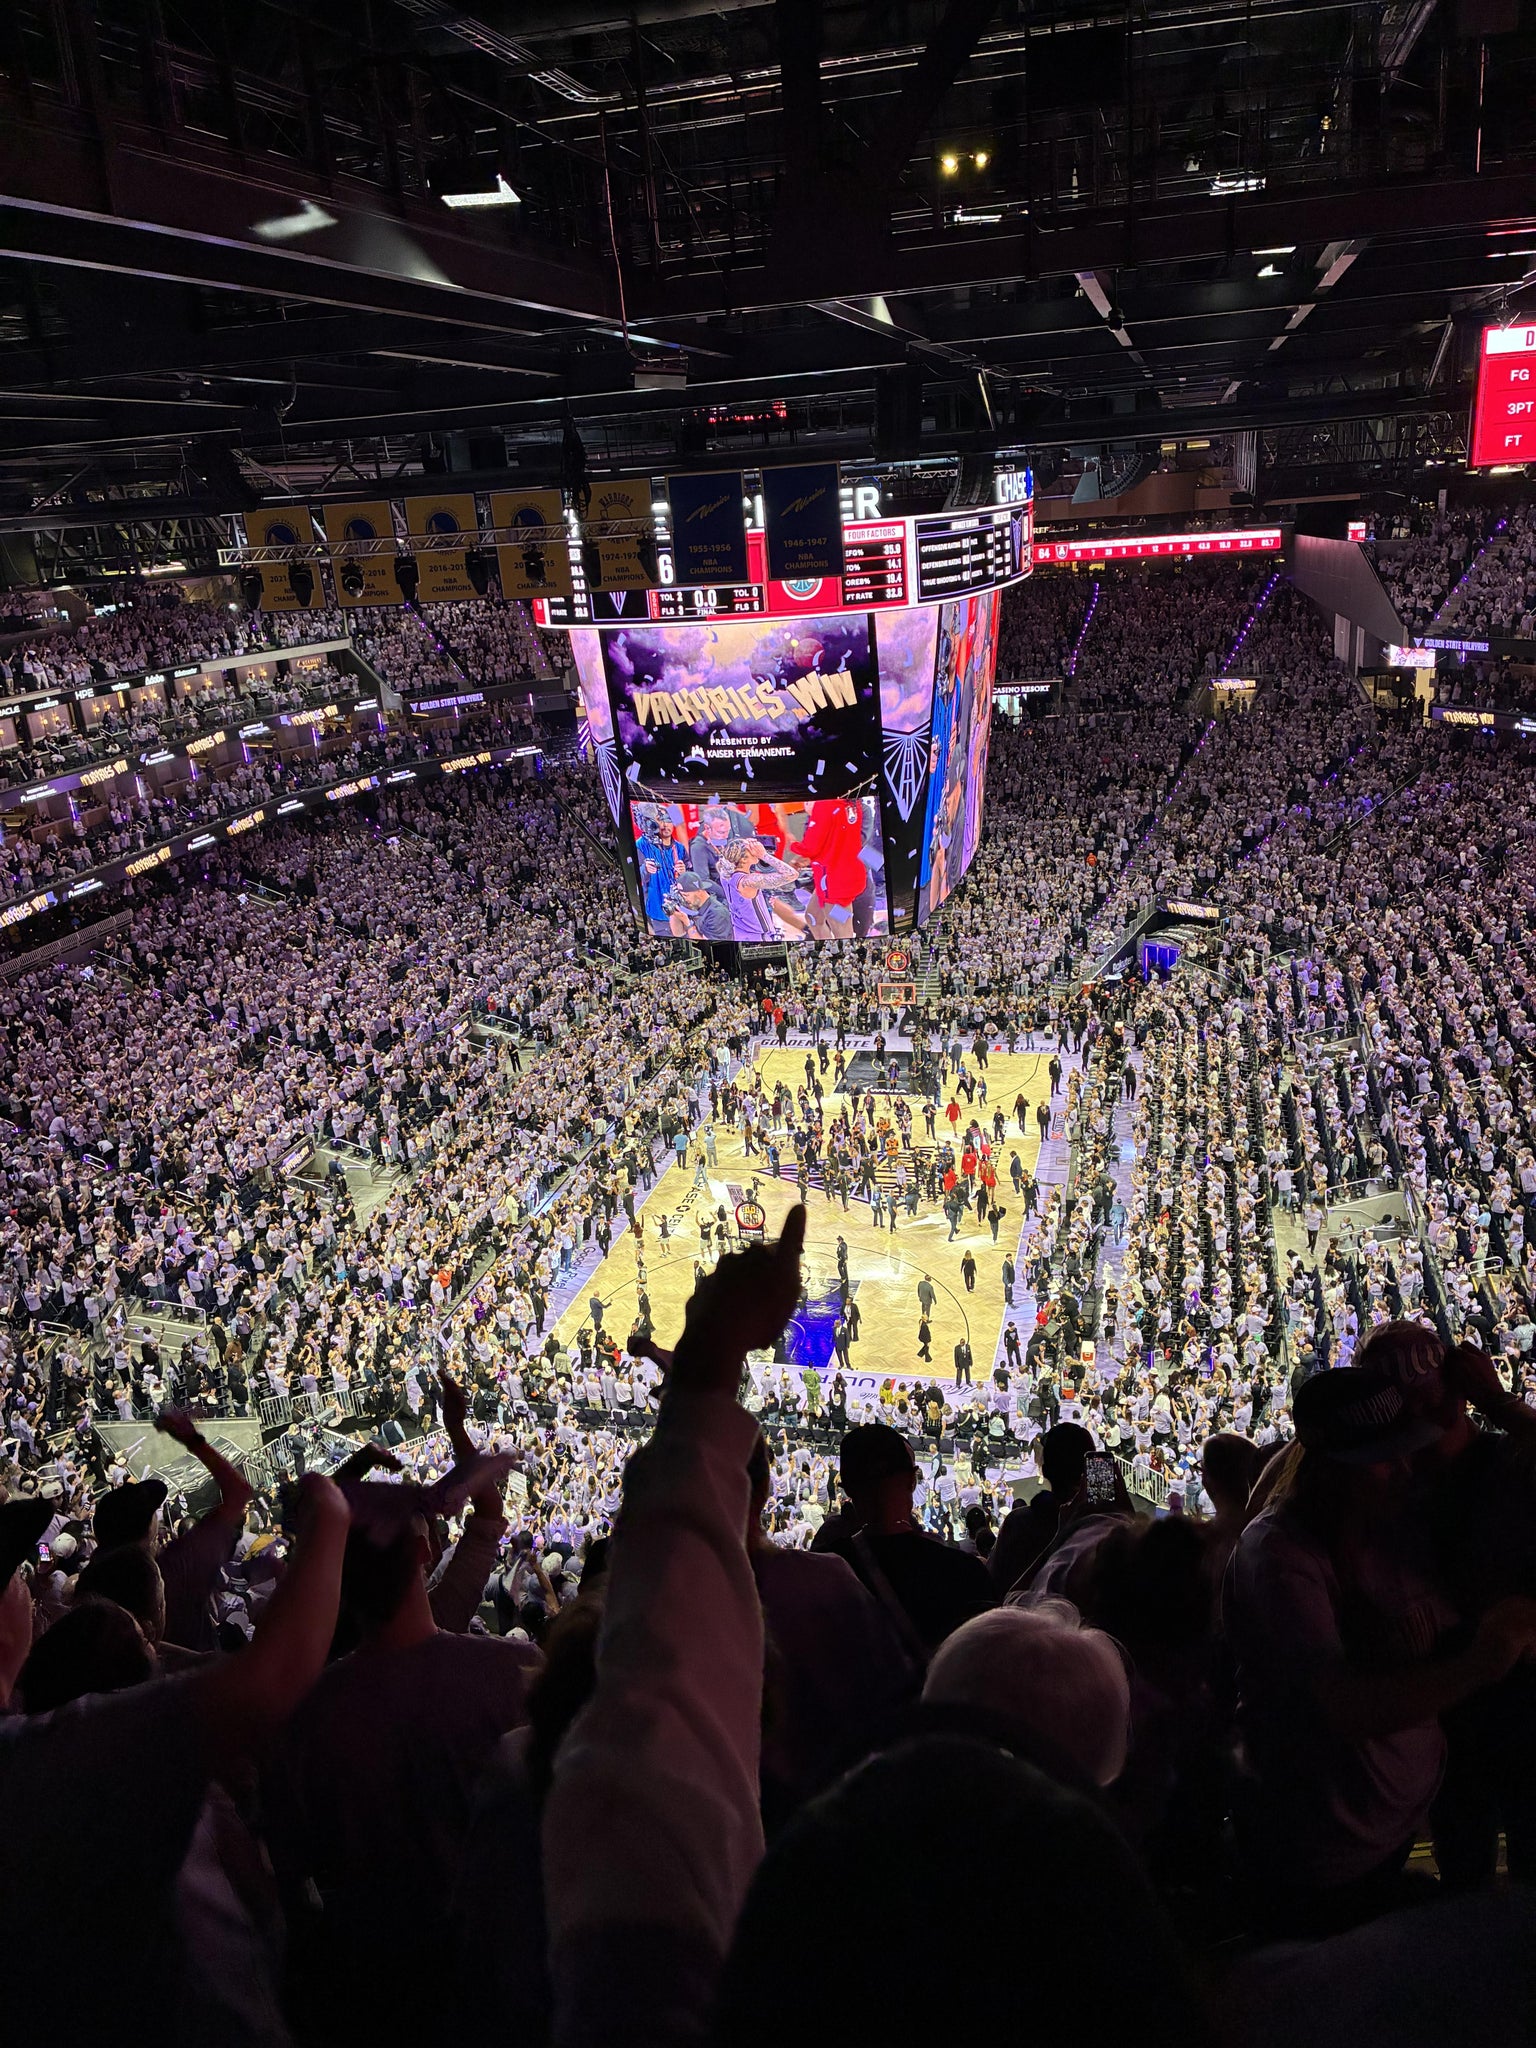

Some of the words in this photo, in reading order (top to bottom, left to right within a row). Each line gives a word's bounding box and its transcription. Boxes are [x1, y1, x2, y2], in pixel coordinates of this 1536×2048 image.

[1510, 369, 1530, 382] FG
[1507, 401, 1535, 415] 3PT
[1504, 434, 1522, 447] FT
[848, 531, 865, 540] FOUR
[867, 528, 896, 538] FACTORS
[783, 537, 828, 548] 1946-1947
[689, 544, 731, 553] 1955-1956
[1038, 547, 1050, 559] 64
[601, 552, 640, 560] 1974-197
[689, 566, 733, 574] CHAMPIONS
[784, 560, 829, 570] CHAMPIONS
[603, 574, 645, 582] CHAMPIONS
[431, 583, 472, 593] CHAMPIONS
[733, 589, 750, 597] TOL
[660, 593, 674, 601] TOL
[694, 589, 717, 607] 0.0
[697, 608, 717, 616] FINAL
[735, 603, 750, 611] FLS
[1424, 638, 1445, 648] GOLDEN
[1446, 640, 1462, 649] STATE
[992, 686, 1020, 694] CASINO
[1021, 685, 1051, 693] RESORT
[632, 680, 786, 726] VALKYRIES
[786, 671, 857, 716] WIN
[420, 700, 440, 711] GOLDEN
[440, 697, 457, 707] STATE
[710, 737, 758, 746] PRESENTED
[760, 736, 772, 744] BY
[707, 749, 734, 759] KAISER
